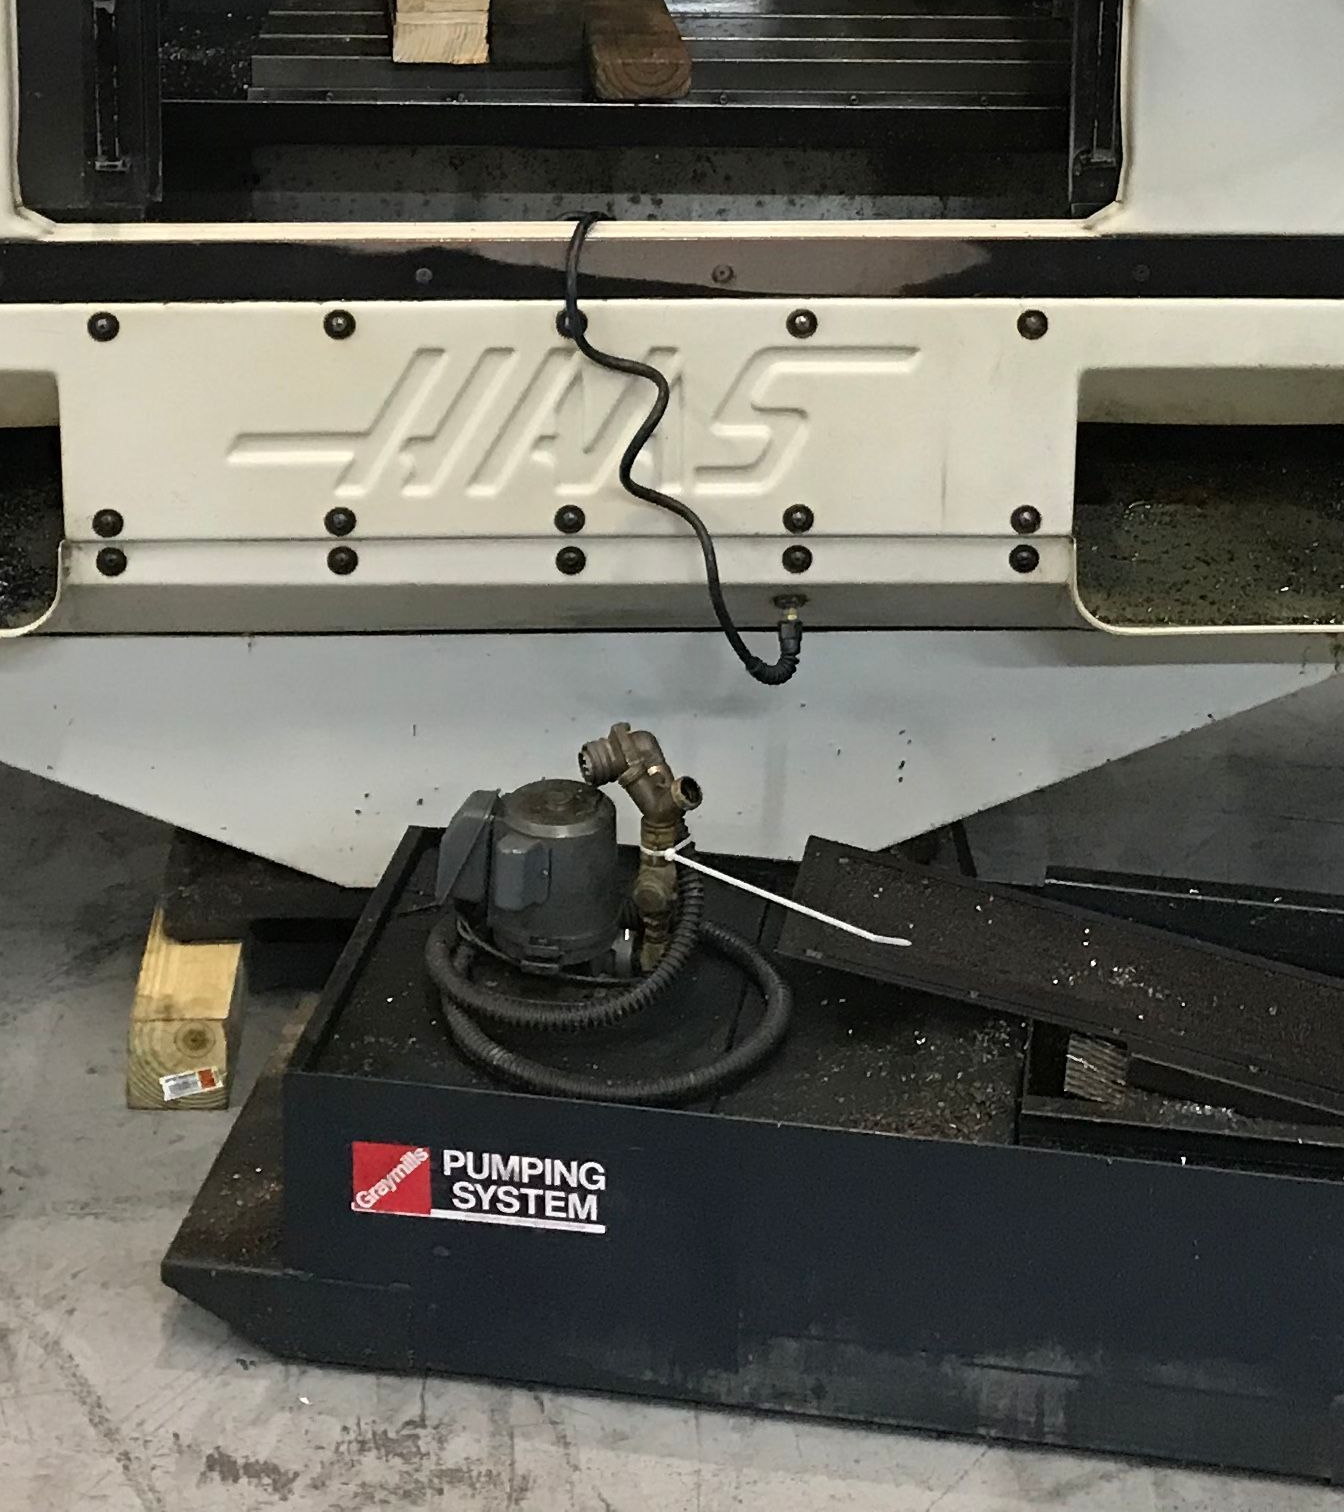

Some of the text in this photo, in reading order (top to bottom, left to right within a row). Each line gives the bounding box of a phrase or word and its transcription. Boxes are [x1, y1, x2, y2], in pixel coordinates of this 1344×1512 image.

[227, 345, 923, 498] HAAS
[355, 1146, 606, 1209] Graymills PUMPING
[452, 1181, 598, 1221] SYSTEM
